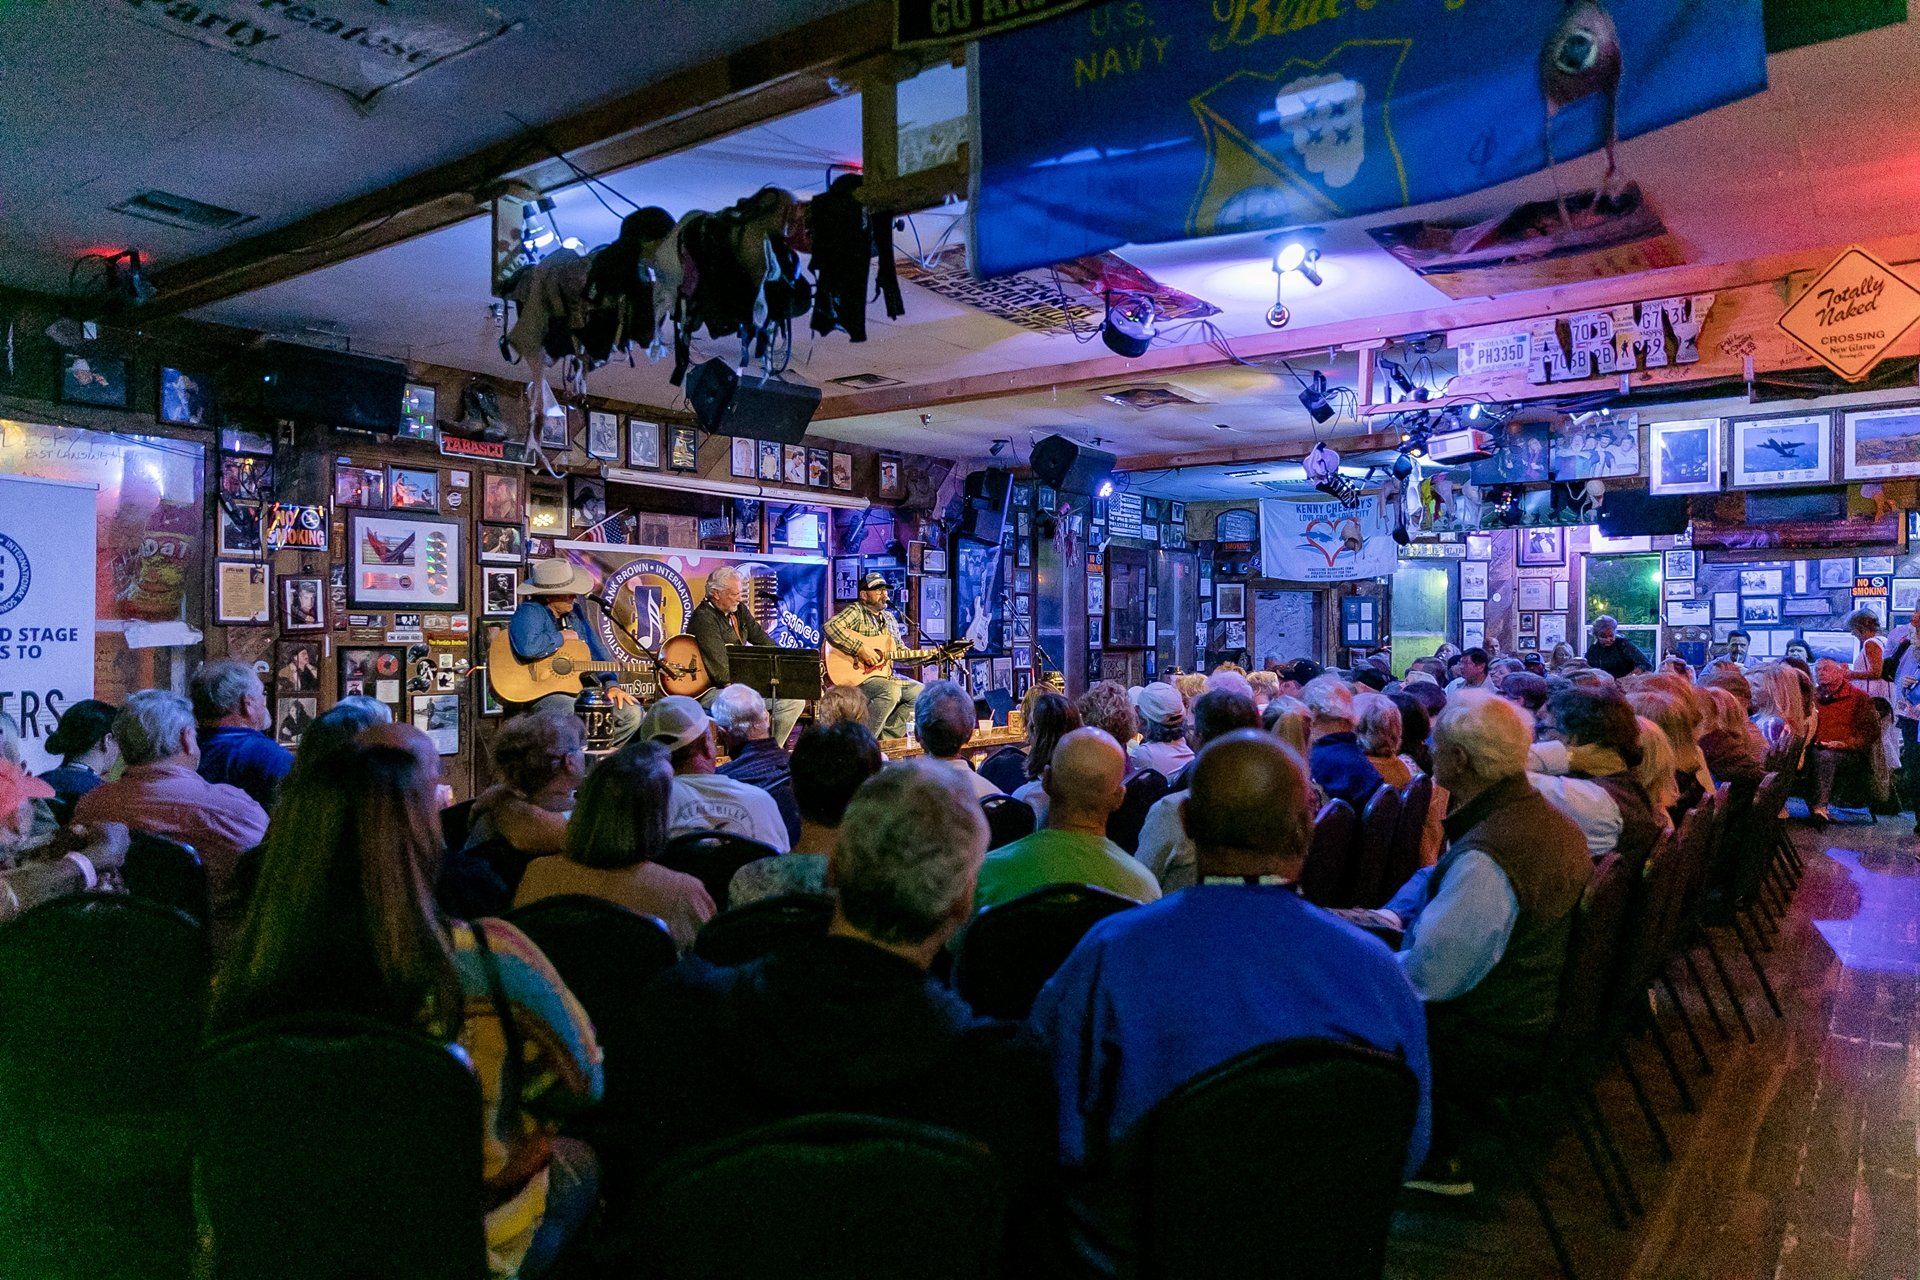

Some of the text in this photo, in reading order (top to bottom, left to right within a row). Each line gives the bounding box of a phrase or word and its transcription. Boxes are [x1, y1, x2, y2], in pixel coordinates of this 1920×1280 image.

[1073, 33, 1172, 90] NAVY
[913, 278, 992, 310] BEACH
[1817, 275, 1885, 309] Totally
[1815, 296, 1877, 327] Naked
[1821, 330, 1885, 345] CROSSING
[1478, 344, 1524, 366] PH335D
[1830, 343, 1876, 353] New Glarus
[443, 435, 504, 458] TABASCO
[274, 510, 296, 526] NO
[1296, 503, 1323, 514] KENNY
[1299, 513, 1314, 522] LOVE
[1355, 510, 1370, 518] CITY
[267, 528, 325, 546] SMOKING
[5, 540, 31, 599] INTERNATIONAL
[616, 562, 649, 584] BROWN
[1852, 586, 1888, 596] SMOKING
[1857, 578, 1869, 587] NO
[655, 564, 692, 634] INTERNATIONAL
[18, 628, 78, 641] STAGE
[602, 620, 628, 663] FESTIVAL
[17, 645, 42, 659] TO
